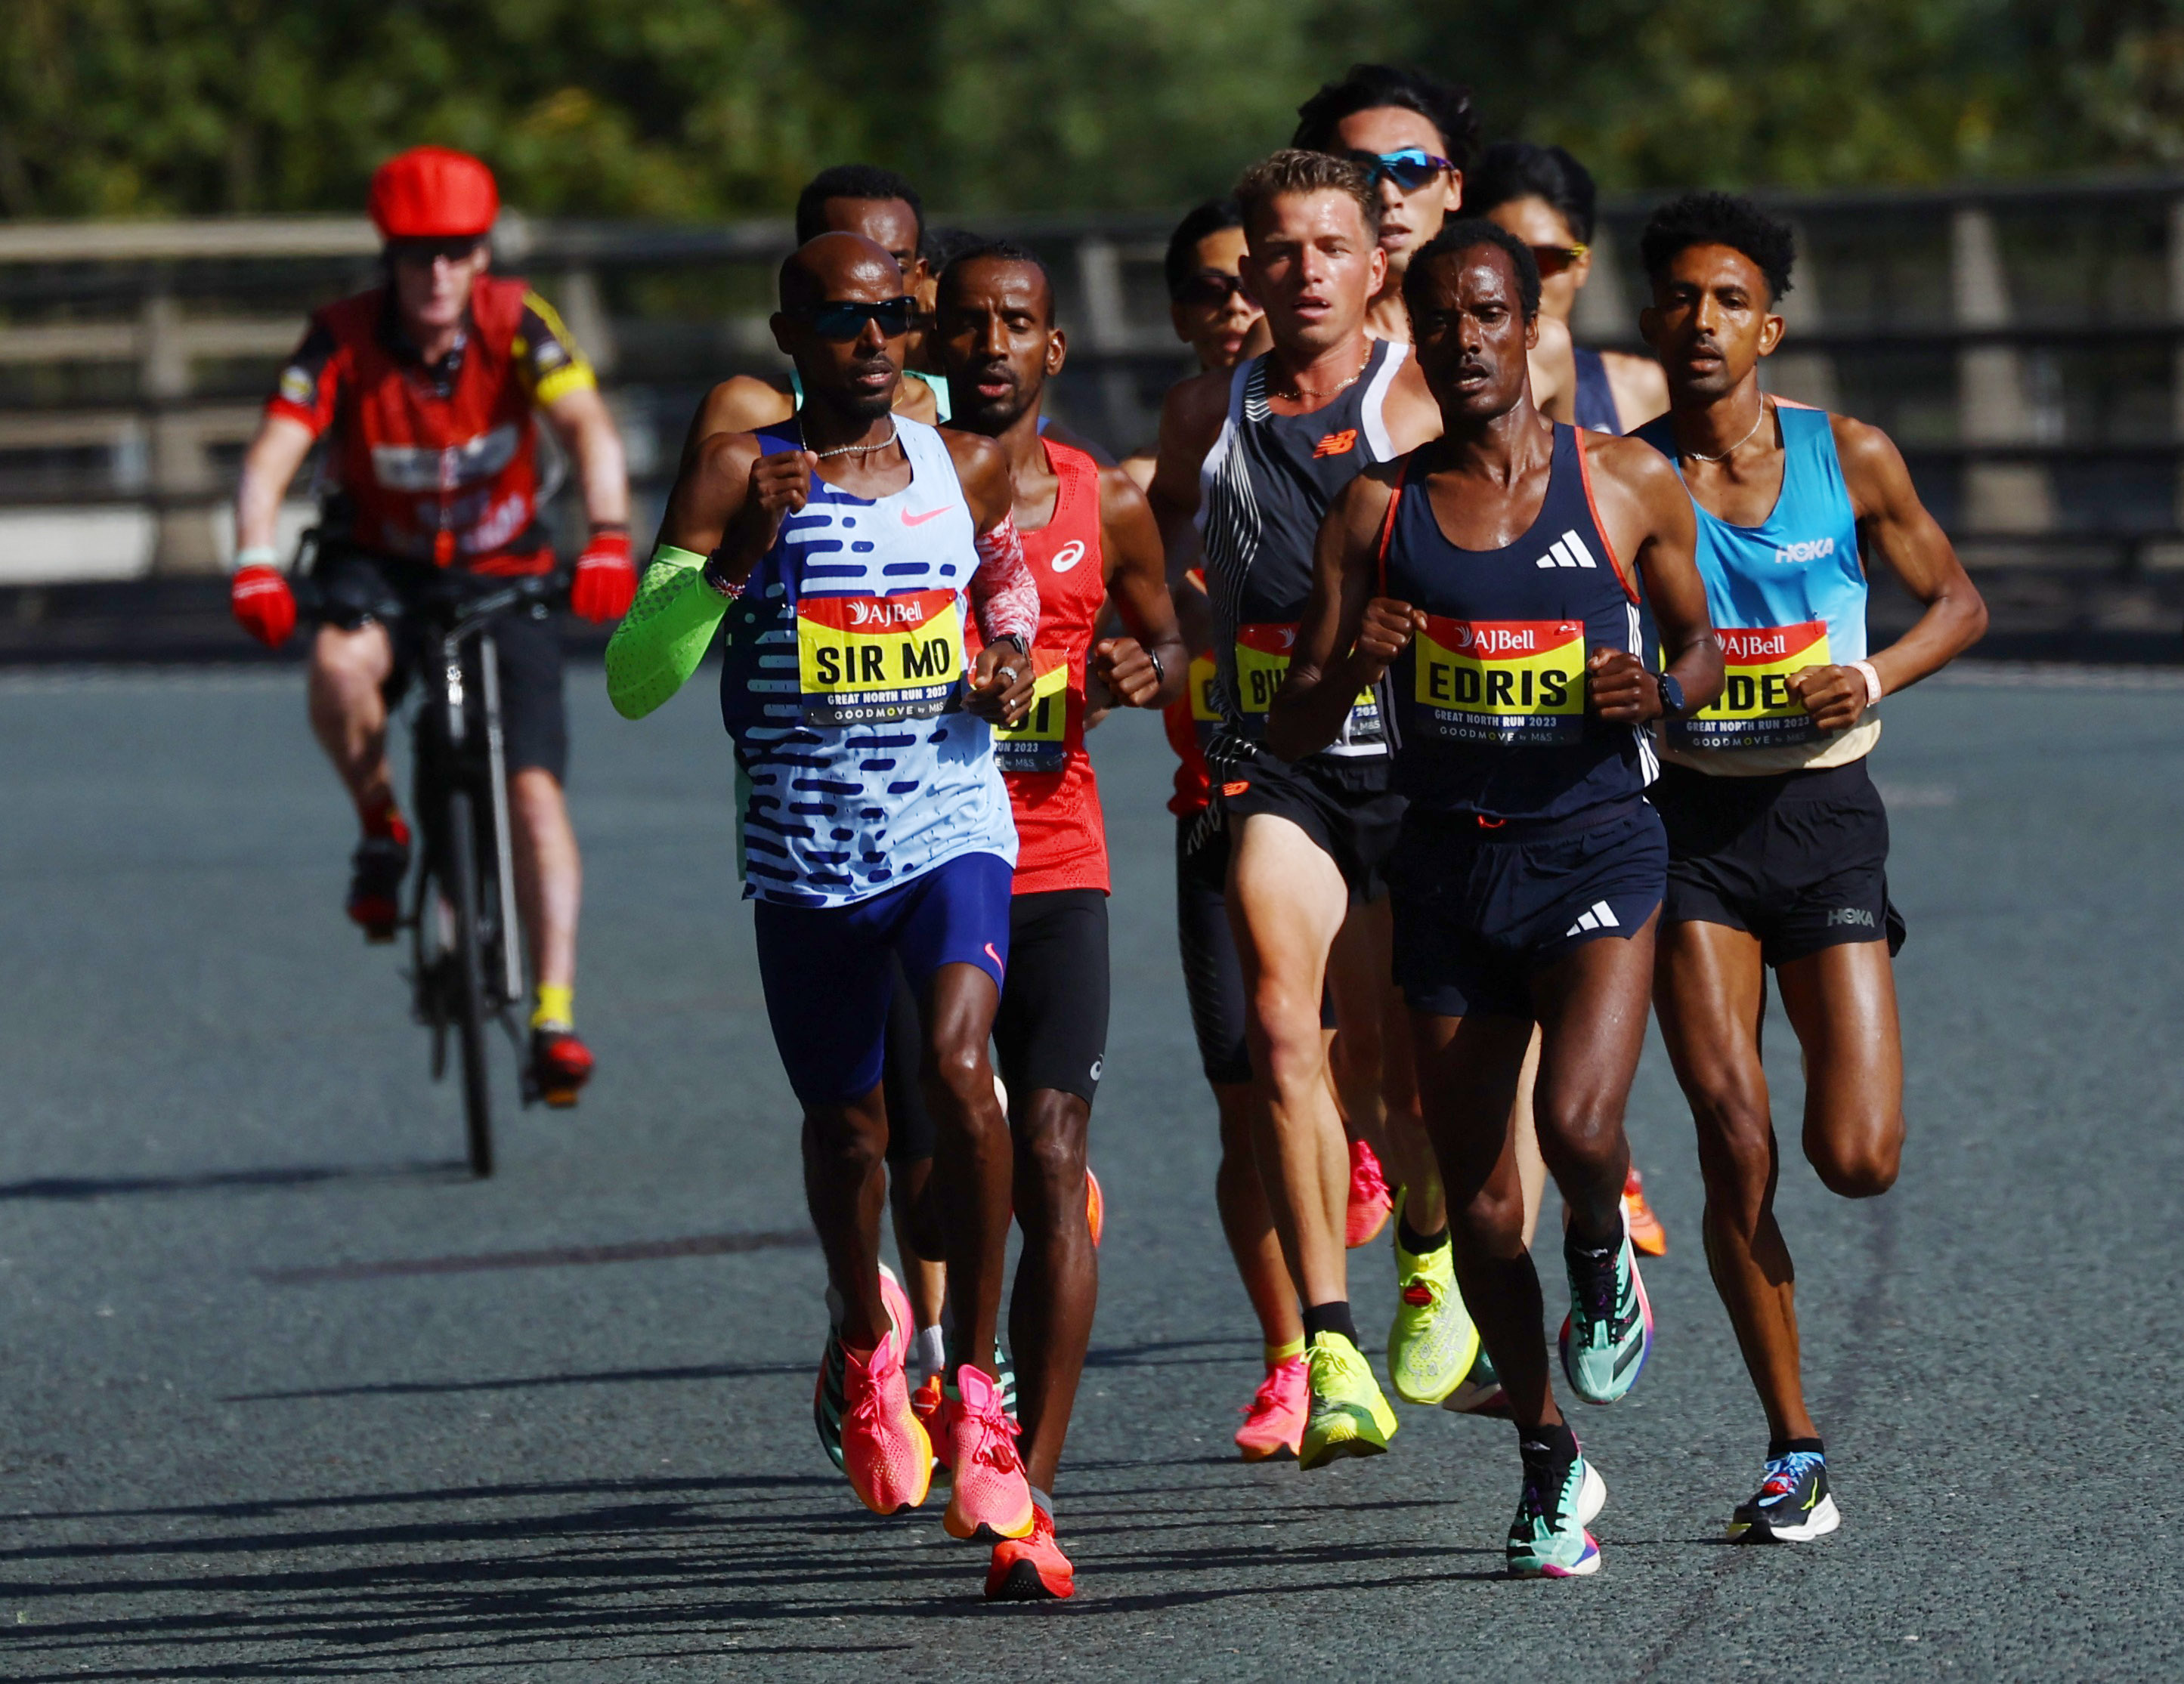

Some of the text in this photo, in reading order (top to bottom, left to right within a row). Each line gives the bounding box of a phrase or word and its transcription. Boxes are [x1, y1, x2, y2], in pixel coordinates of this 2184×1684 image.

[1774, 537, 1835, 564] HOKA
[816, 644, 886, 684] SIR
[902, 638, 951, 679] MO
[1429, 661, 1568, 707] EDRIS
[828, 684, 948, 706] GREAT NORTH RUN 2023
[834, 706, 914, 720] GOODMOVE
[929, 702, 944, 713] M&S
[1355, 705, 1378, 717] 202
[1434, 709, 1557, 728] GREAT NORTH RUN 2023
[1687, 715, 1810, 732] GREAT NORTH RUN 2023
[1440, 726, 1514, 742] GOODMOVE
[1531, 733, 1552, 742] M&S
[1693, 735, 1770, 747] GOODMOVE
[1014, 742, 1039, 753] 2023
[1016, 758, 1035, 767] M&S
[1827, 907, 1875, 928] HOKA
